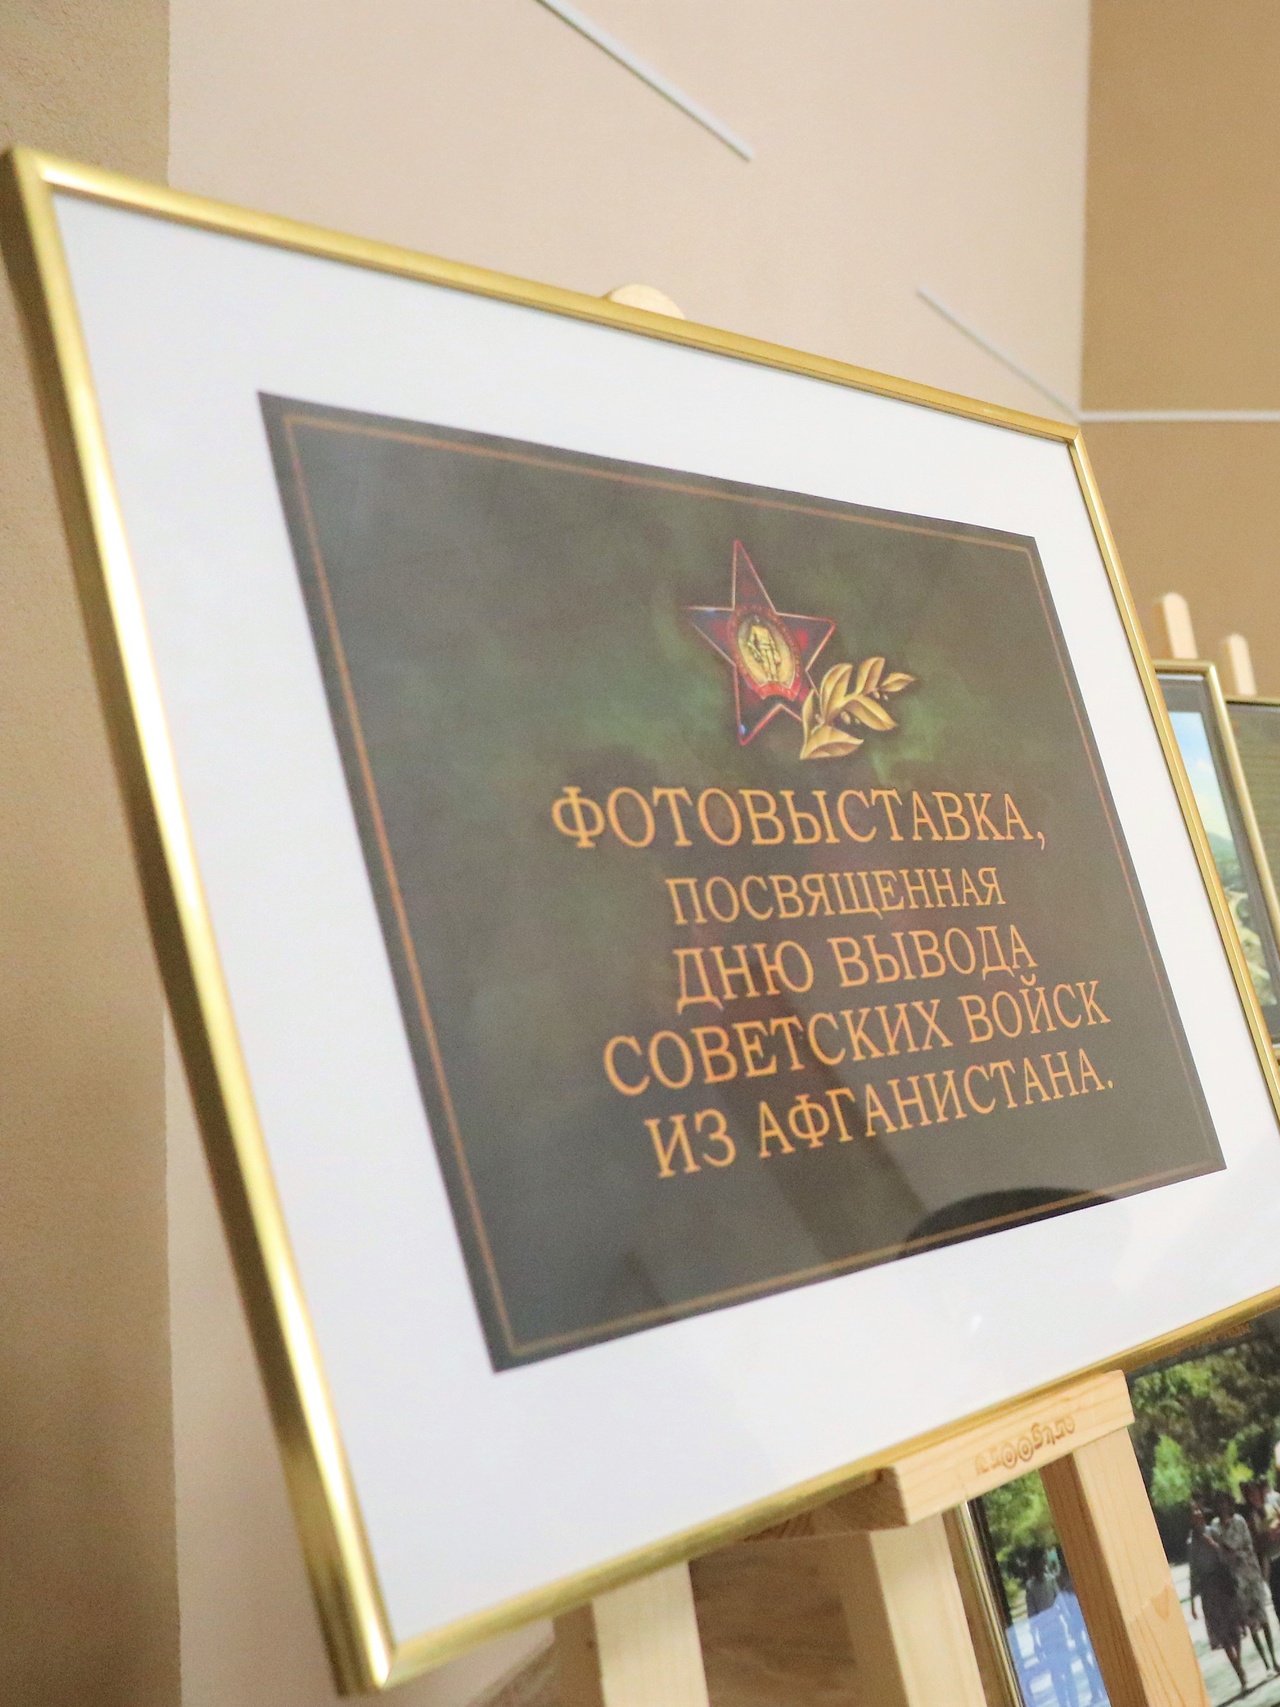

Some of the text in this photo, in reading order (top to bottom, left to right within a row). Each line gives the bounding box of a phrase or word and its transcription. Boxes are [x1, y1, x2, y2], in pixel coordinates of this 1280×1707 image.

[551, 786, 1047, 851] ФОТОВЫСТАВКА,
[665, 867, 1007, 926] ПОСВЯЩЕННАЯ
[673, 924, 1039, 1014] ДНЮ ВЫВОДА
[602, 973, 1111, 1097] СОВЕТСКИХ ВОЙСК
[645, 1047, 1115, 1179] ИЗ АФГАНИСТАНА.
